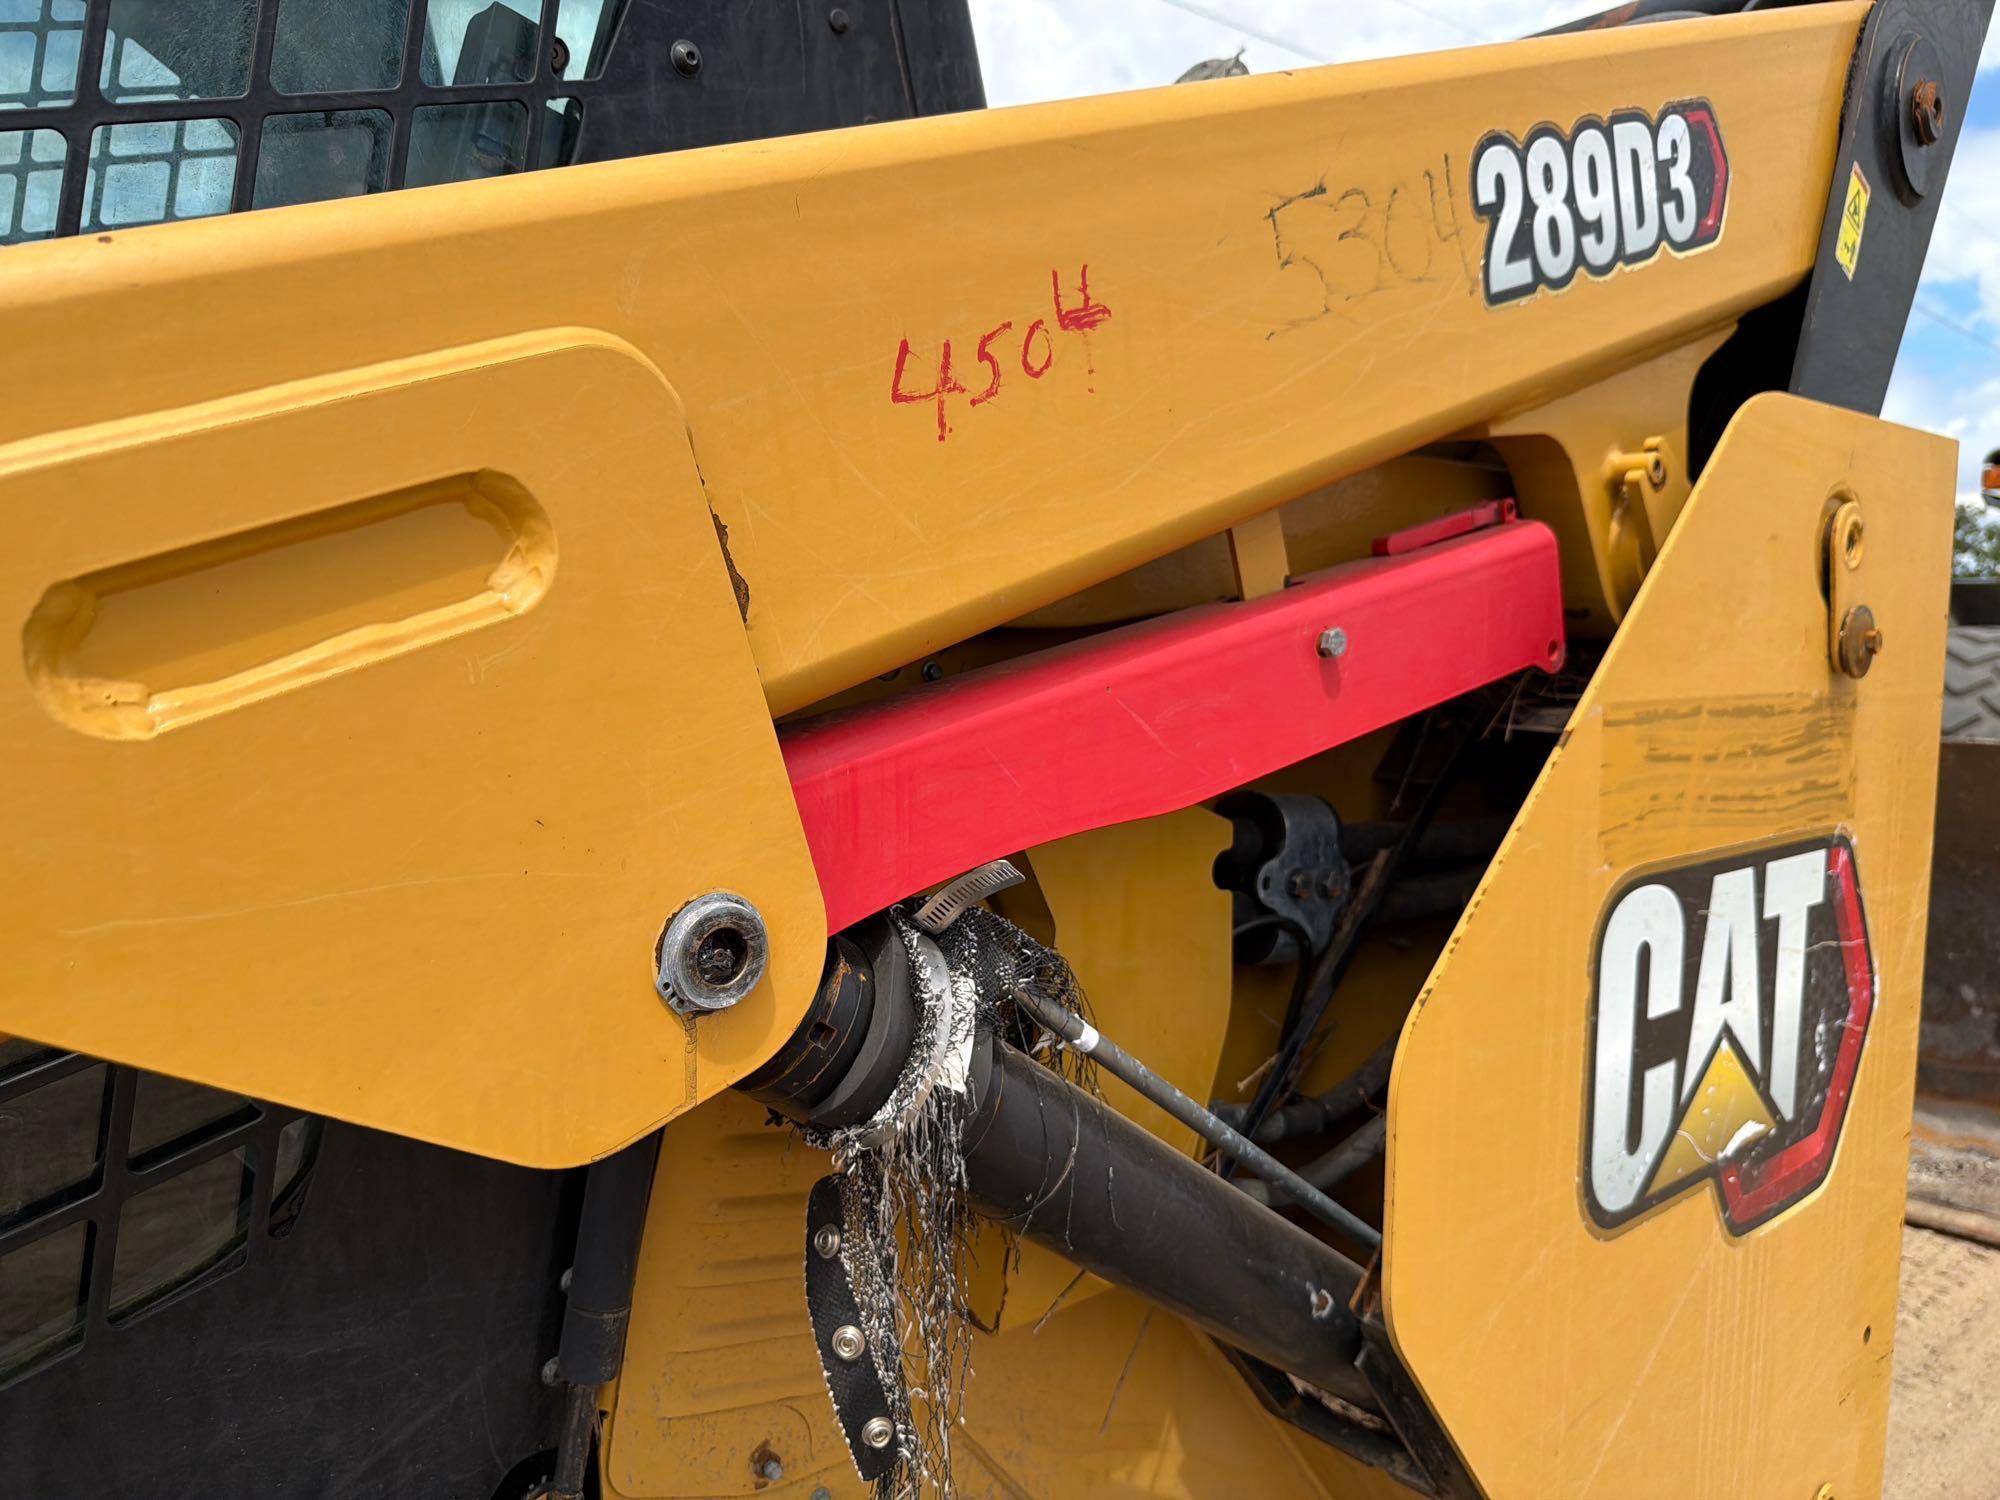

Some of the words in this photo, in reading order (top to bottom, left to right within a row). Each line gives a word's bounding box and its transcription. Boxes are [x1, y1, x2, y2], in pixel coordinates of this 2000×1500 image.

[1265, 153, 1475, 341] 5304
[1476, 113, 1698, 295] 289D3
[891, 264, 1112, 442] 4504
[1592, 848, 1828, 1213] CAT
